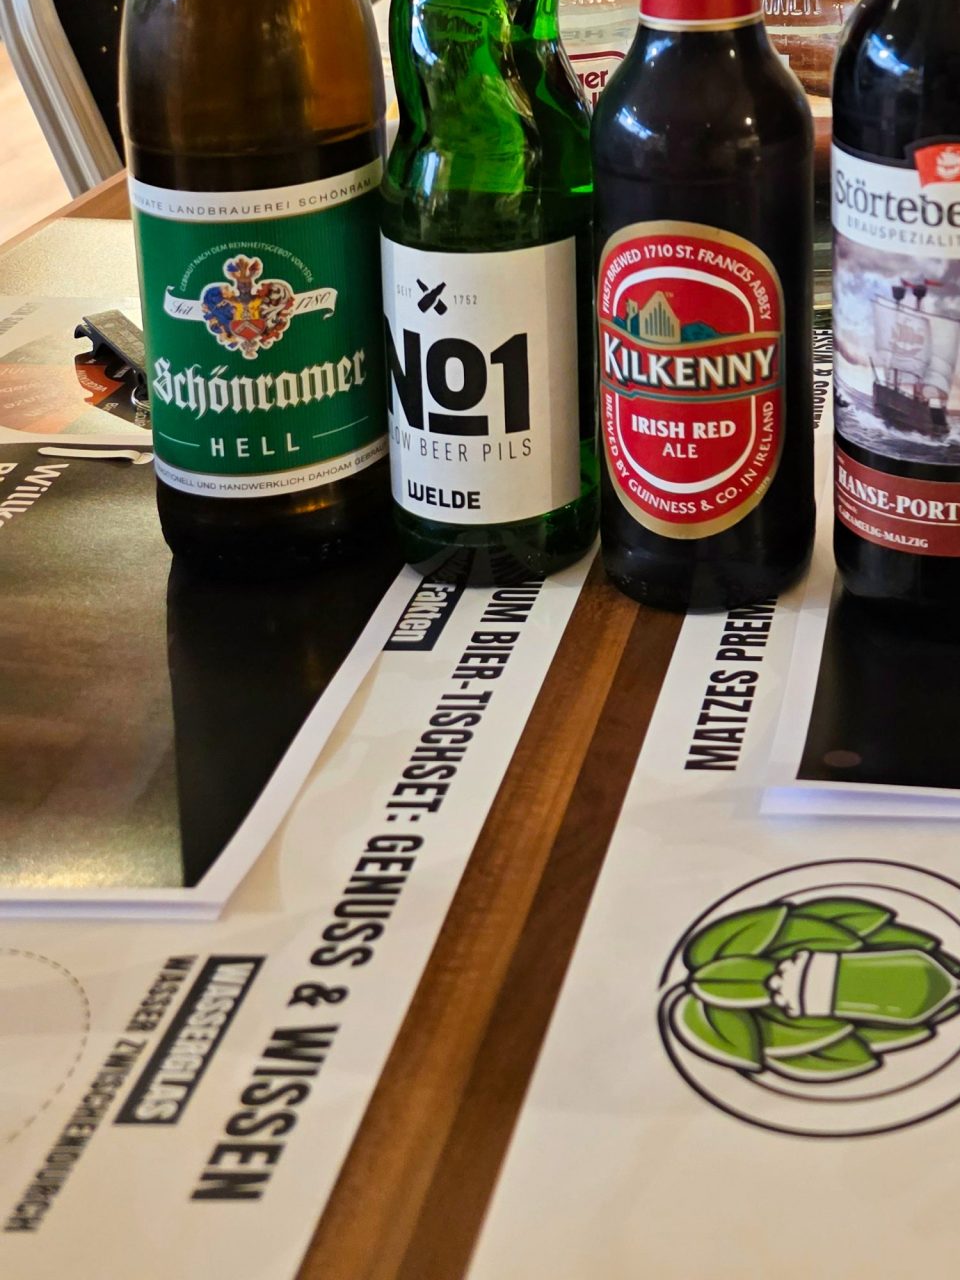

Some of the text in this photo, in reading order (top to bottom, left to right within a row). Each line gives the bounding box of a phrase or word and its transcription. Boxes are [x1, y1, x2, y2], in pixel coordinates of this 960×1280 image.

[168, 178, 372, 216] LANDBRAUEREI SCHÖNRAM
[211, 244, 228, 255] DEM
[453, 294, 478, 307] 1752
[602, 244, 772, 320] FIRST BREWED 1710 ST. FRANCIS ABBEY
[153, 348, 366, 420] Schönramer
[603, 331, 778, 389] KILKENNY
[210, 432, 301, 458] HELL
[420, 439, 469, 462] BEER
[483, 438, 532, 462] PILS
[631, 414, 737, 439] IRISH RED
[605, 393, 619, 457] BREWED
[616, 459, 630, 478] BY
[628, 478, 697, 514] GUINNESS
[700, 499, 714, 512] &
[715, 486, 743, 505] CO.
[740, 467, 758, 487] IN
[753, 401, 774, 468] IRELAND
[662, 443, 699, 459] ALE
[197, 481, 217, 491] UND
[219, 476, 305, 492] HANDWERKLICH
[308, 461, 352, 482] DAHOAM
[407, 479, 481, 511] WELDE
[386, 630, 521, 824] BIER-TISCHSET:
[684, 669, 759, 771] MATZES
[309, 834, 426, 969] GENUSS
[126, 955, 200, 1033] WASSER
[286, 982, 350, 1008] &
[132, 962, 257, 1122] WASSERGLAS
[189, 1023, 340, 1203] WISSEN
